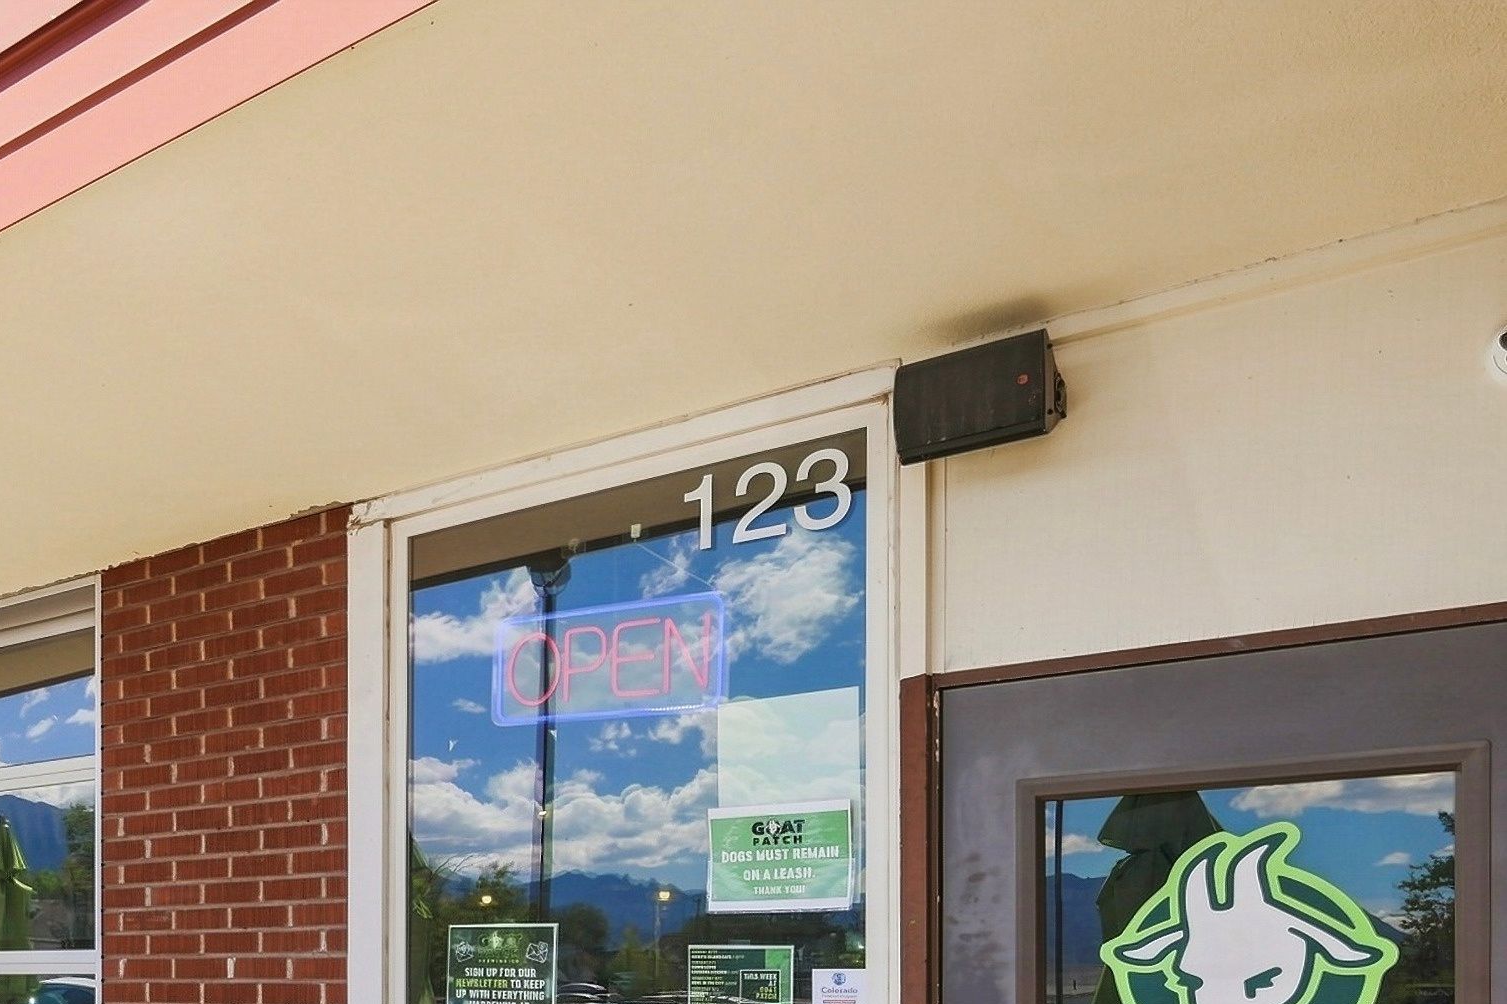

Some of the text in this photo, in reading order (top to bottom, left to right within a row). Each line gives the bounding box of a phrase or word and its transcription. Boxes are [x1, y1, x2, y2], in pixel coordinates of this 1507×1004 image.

[684, 448, 852, 550] 123
[506, 609, 712, 707] OPEN
[751, 818, 805, 836] GOAT
[752, 835, 803, 846] PATCH
[721, 845, 839, 863] DOGS MUST REMAIN
[743, 866, 816, 881] ON A LEASH.
[753, 885, 806, 895] THANK YOU!
[465, 967, 536, 978] SIGN UP FOR OUR
[456, 978, 545, 989] NEWSLETTER TO KEEP
[456, 989, 545, 1001] UP WITH EVERYTHING
[821, 986, 858, 994] Colorado
